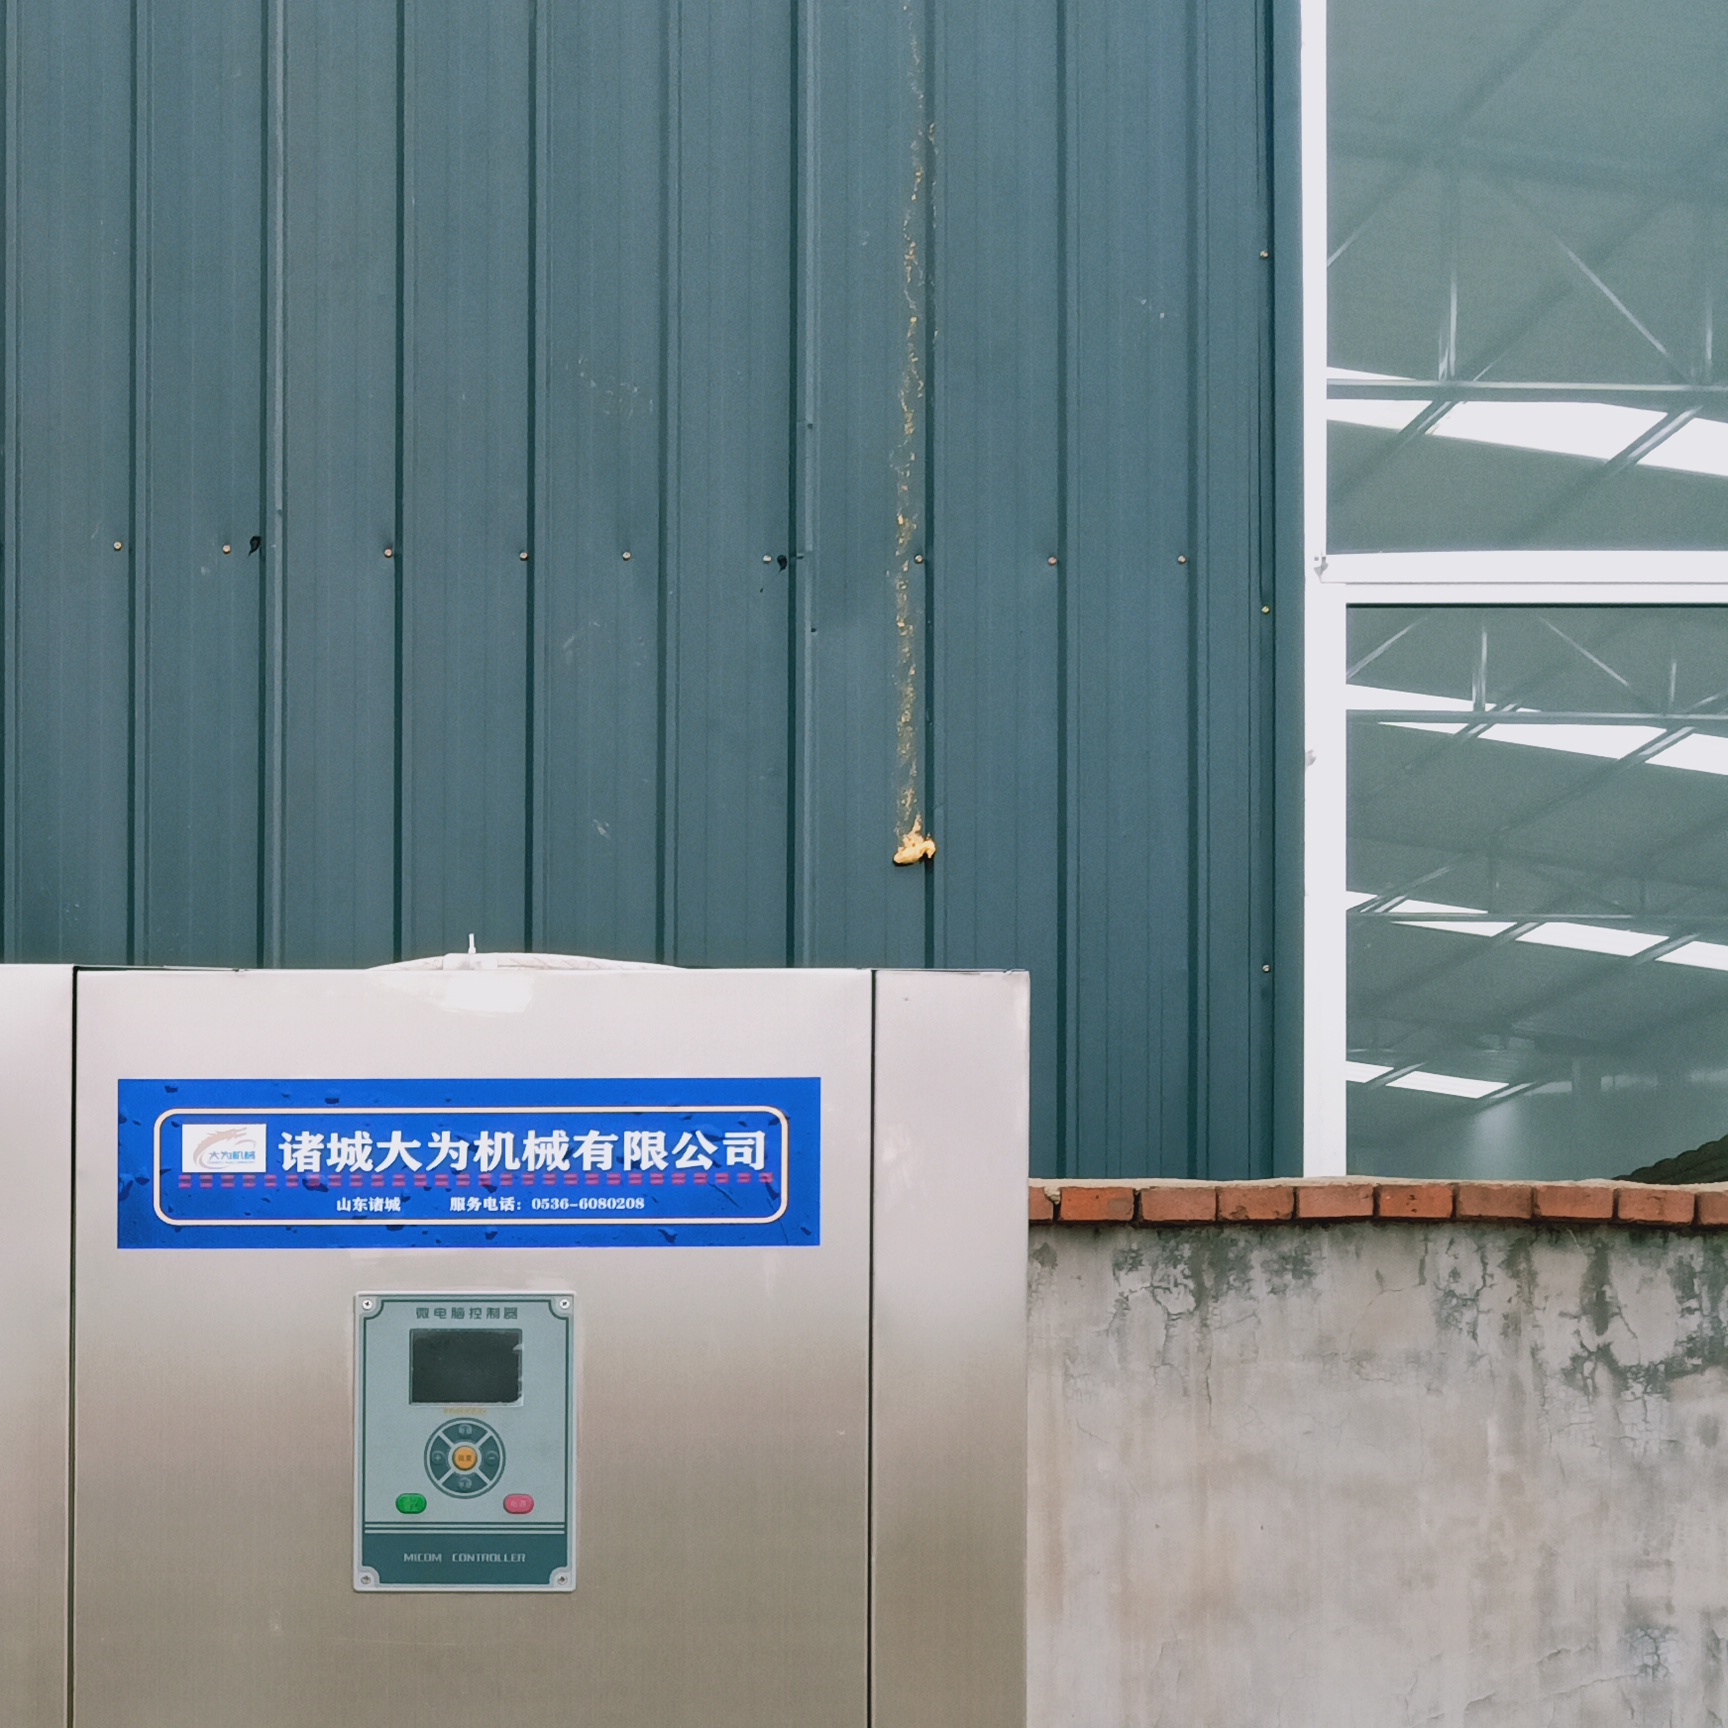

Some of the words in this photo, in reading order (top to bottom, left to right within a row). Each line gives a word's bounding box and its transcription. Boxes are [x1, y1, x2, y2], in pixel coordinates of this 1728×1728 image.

[277, 1129, 767, 1173] 诸城大为机械有限公司
[336, 1196, 402, 1213] 山东诸城
[415, 1306, 519, 1320] 微电脑控制器
[403, 1552, 442, 1563] MICOM
[452, 1552, 527, 1563] CONTROLLER
